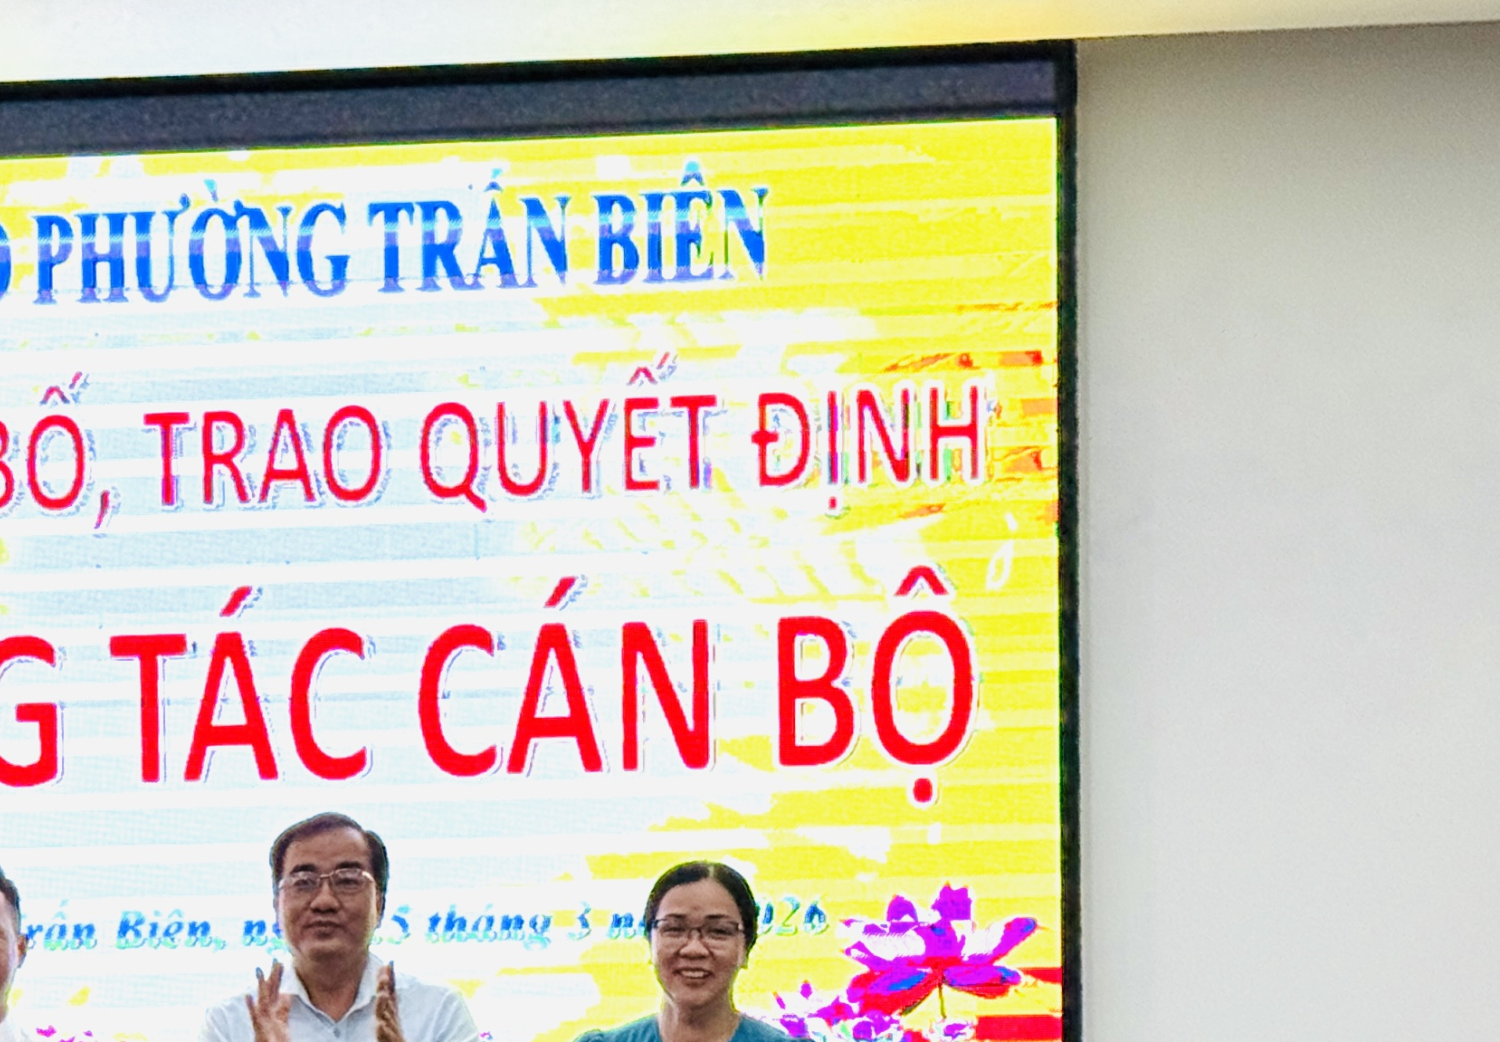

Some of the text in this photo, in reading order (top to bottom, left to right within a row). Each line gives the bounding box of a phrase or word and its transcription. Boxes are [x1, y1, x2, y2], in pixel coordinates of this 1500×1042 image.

[32, 179, 350, 304] PHƯỜNG
[367, 168, 570, 293] TRẤN
[592, 160, 768, 285] BIÊN
[144, 405, 382, 505] TRAO
[420, 352, 717, 512] QUYẾT
[751, 385, 980, 510] ĐỊNH
[110, 586, 367, 781] TÁC
[418, 576, 709, 775] CÁN
[777, 566, 974, 803] BỘ
[22, 898, 98, 951] rấn
[115, 908, 226, 953] Biên,
[425, 903, 552, 951] tháng
[755, 894, 830, 938] 026
